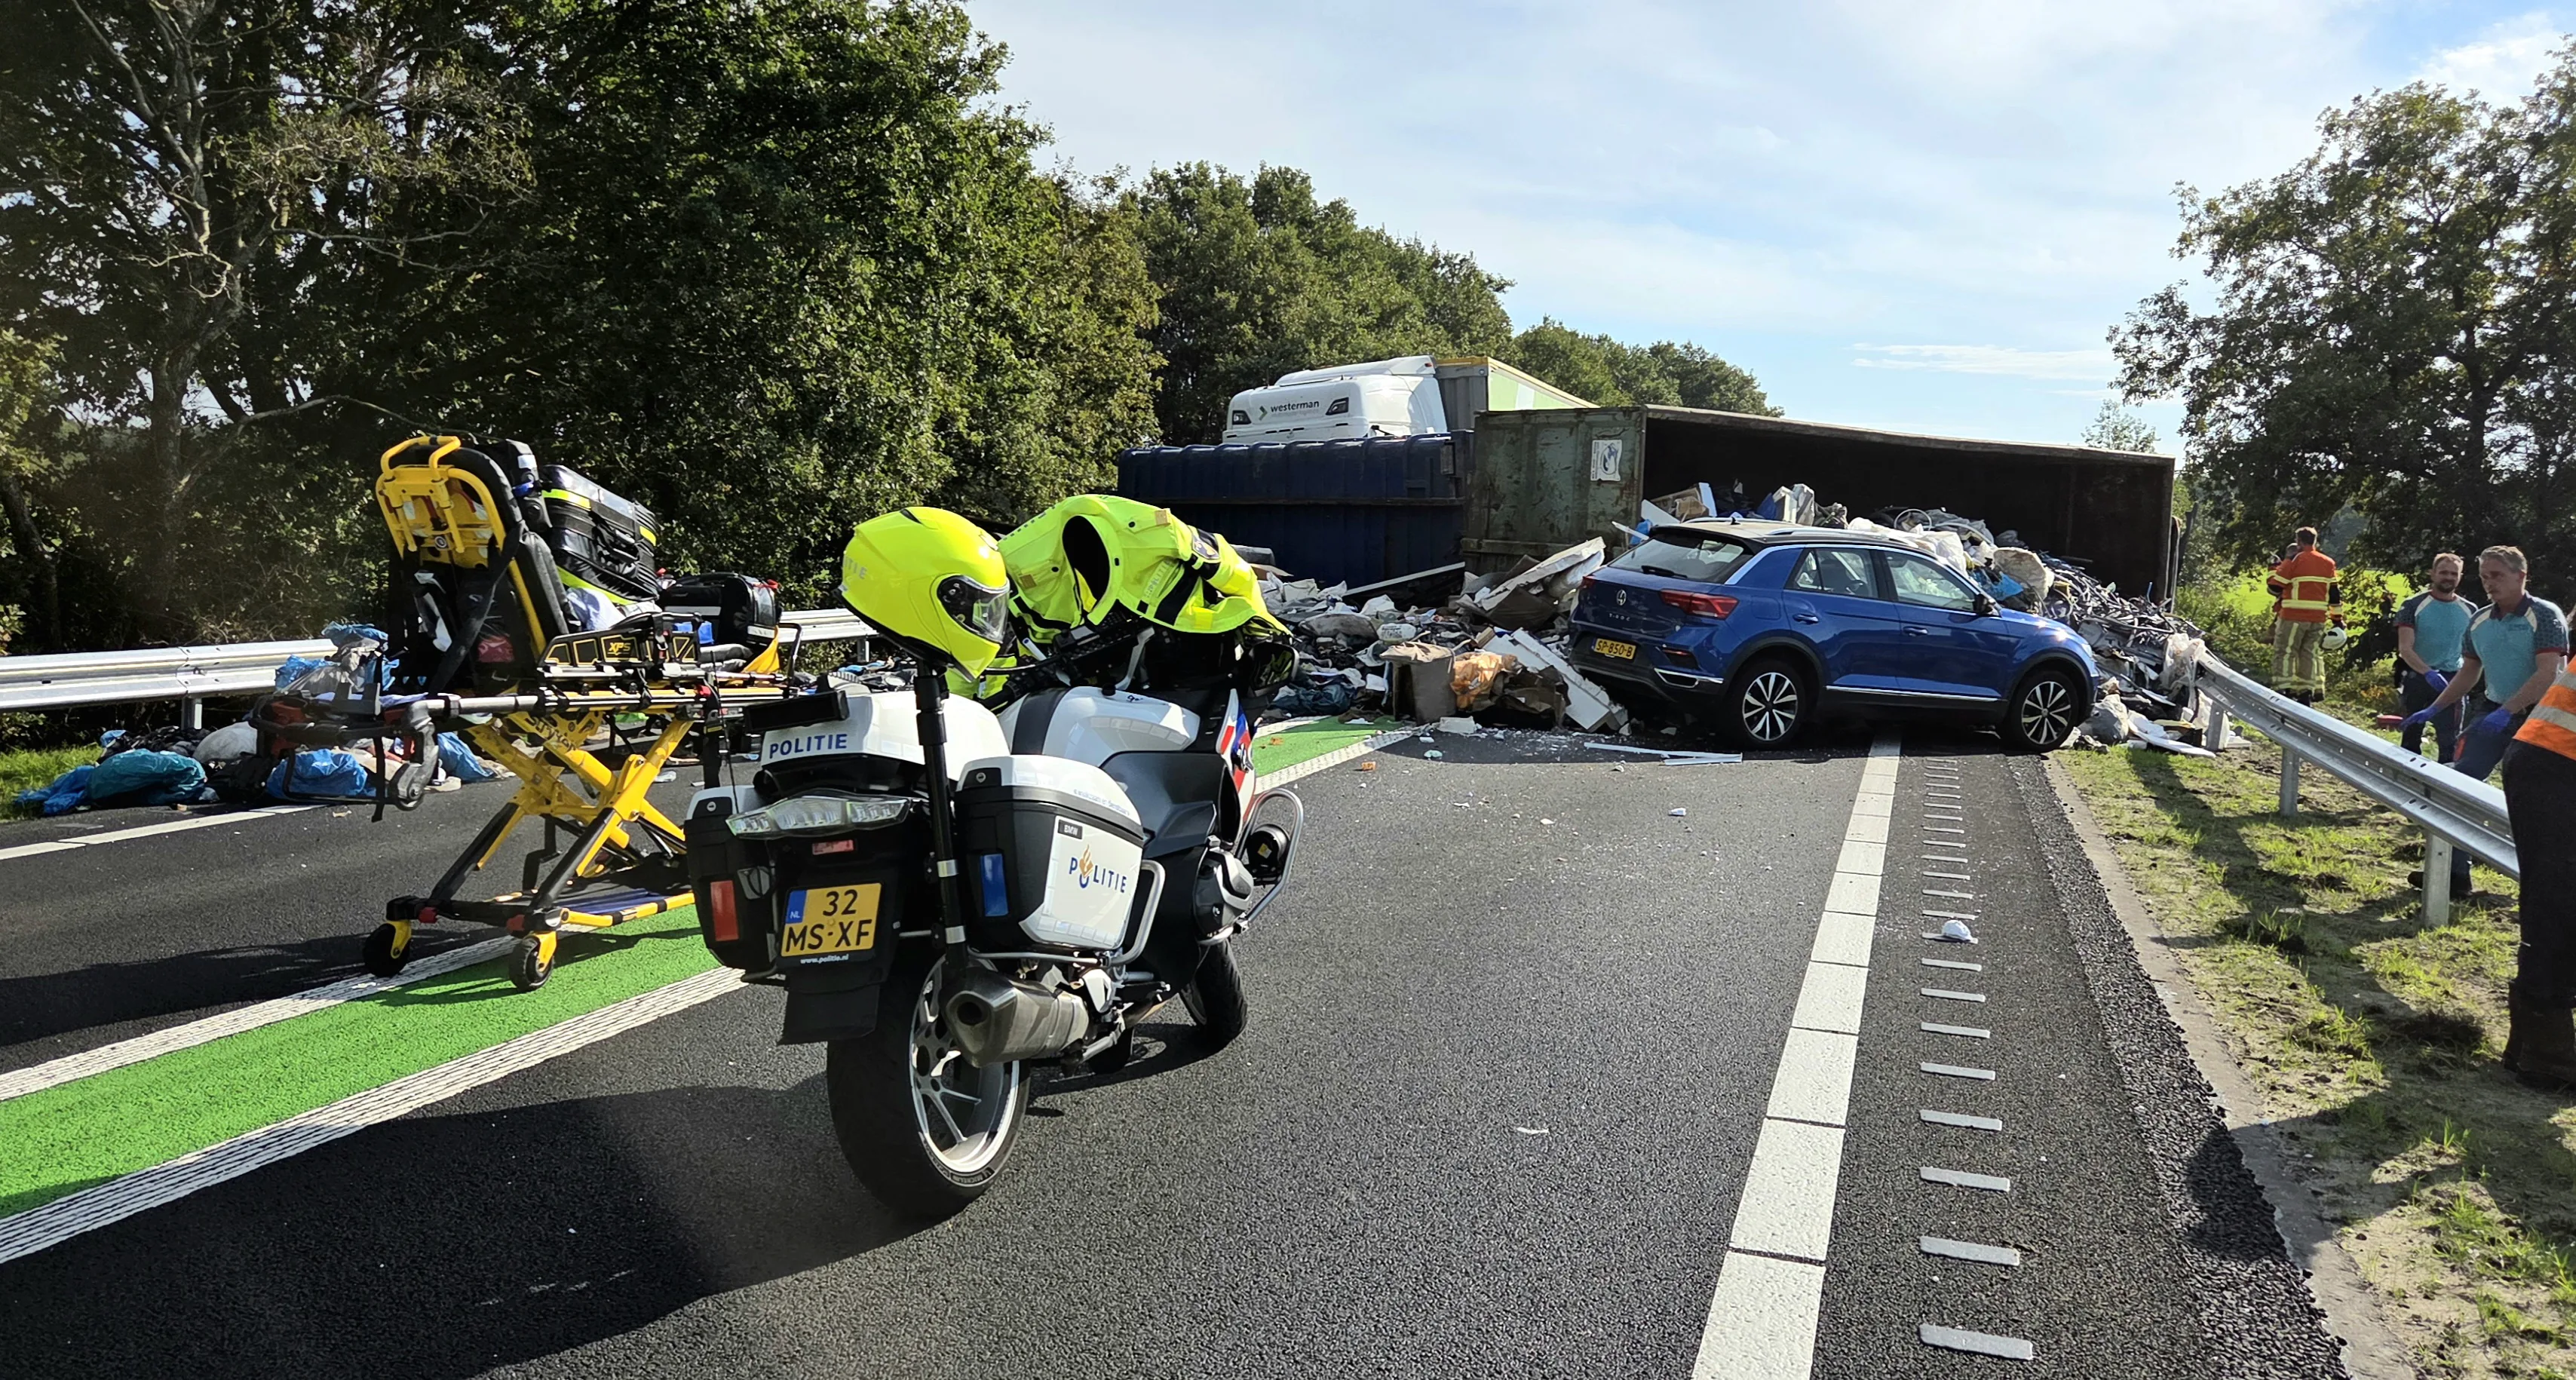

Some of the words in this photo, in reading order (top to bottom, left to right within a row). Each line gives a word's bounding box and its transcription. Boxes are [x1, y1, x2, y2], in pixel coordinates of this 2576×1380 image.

[1271, 401, 1319, 412] westerman
[609, 642, 631, 653] XPS
[1596, 640, 1633, 657] SP-850-B
[769, 734, 847, 759] POLITIE
[1069, 857, 1127, 893] POLITIE
[823, 889, 857, 916] 32
[786, 919, 872, 952] MS-XF
[800, 954, 849, 964] www.politie.nl
